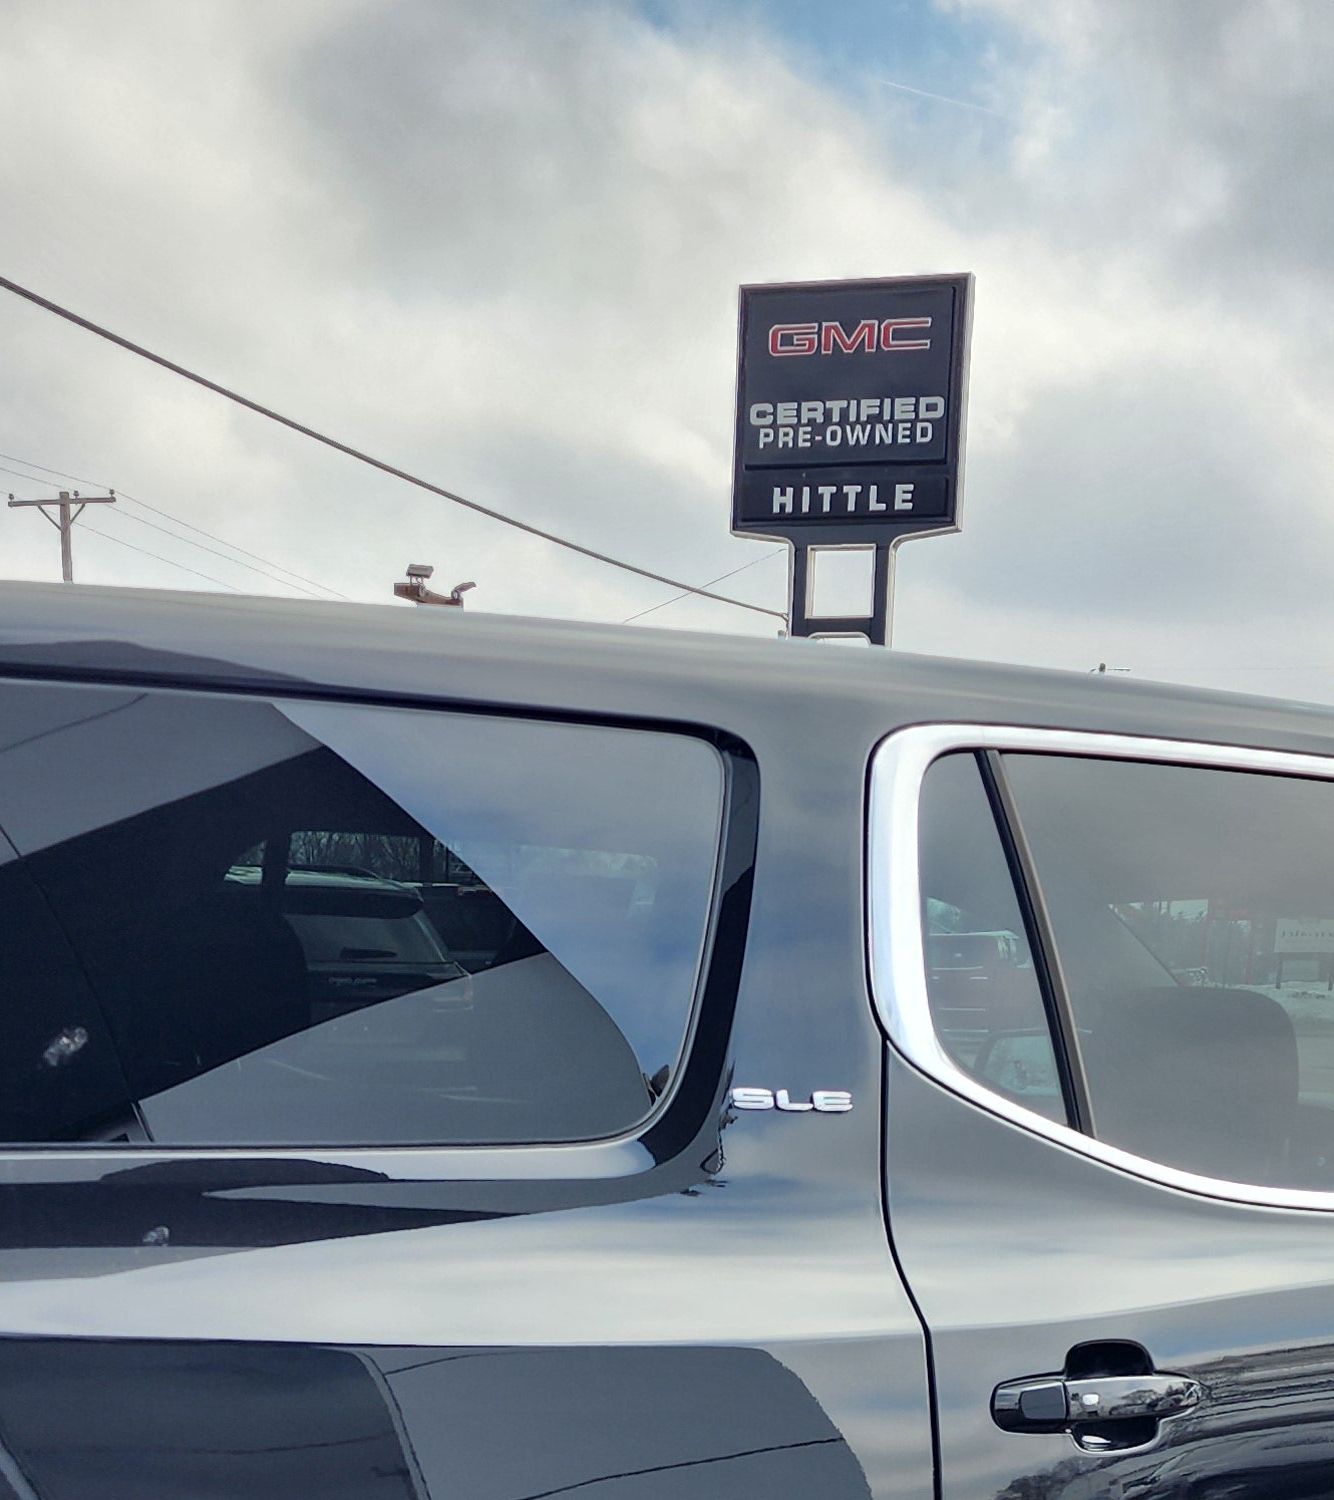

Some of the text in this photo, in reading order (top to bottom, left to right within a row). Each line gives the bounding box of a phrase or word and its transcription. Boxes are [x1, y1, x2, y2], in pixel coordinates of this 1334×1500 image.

[769, 316, 932, 356] GMC
[749, 396, 946, 427] CERTIFIED
[758, 421, 934, 449] PRE-OWNED
[772, 483, 915, 514] HITTLE
[731, 1086, 854, 1112] SLE
